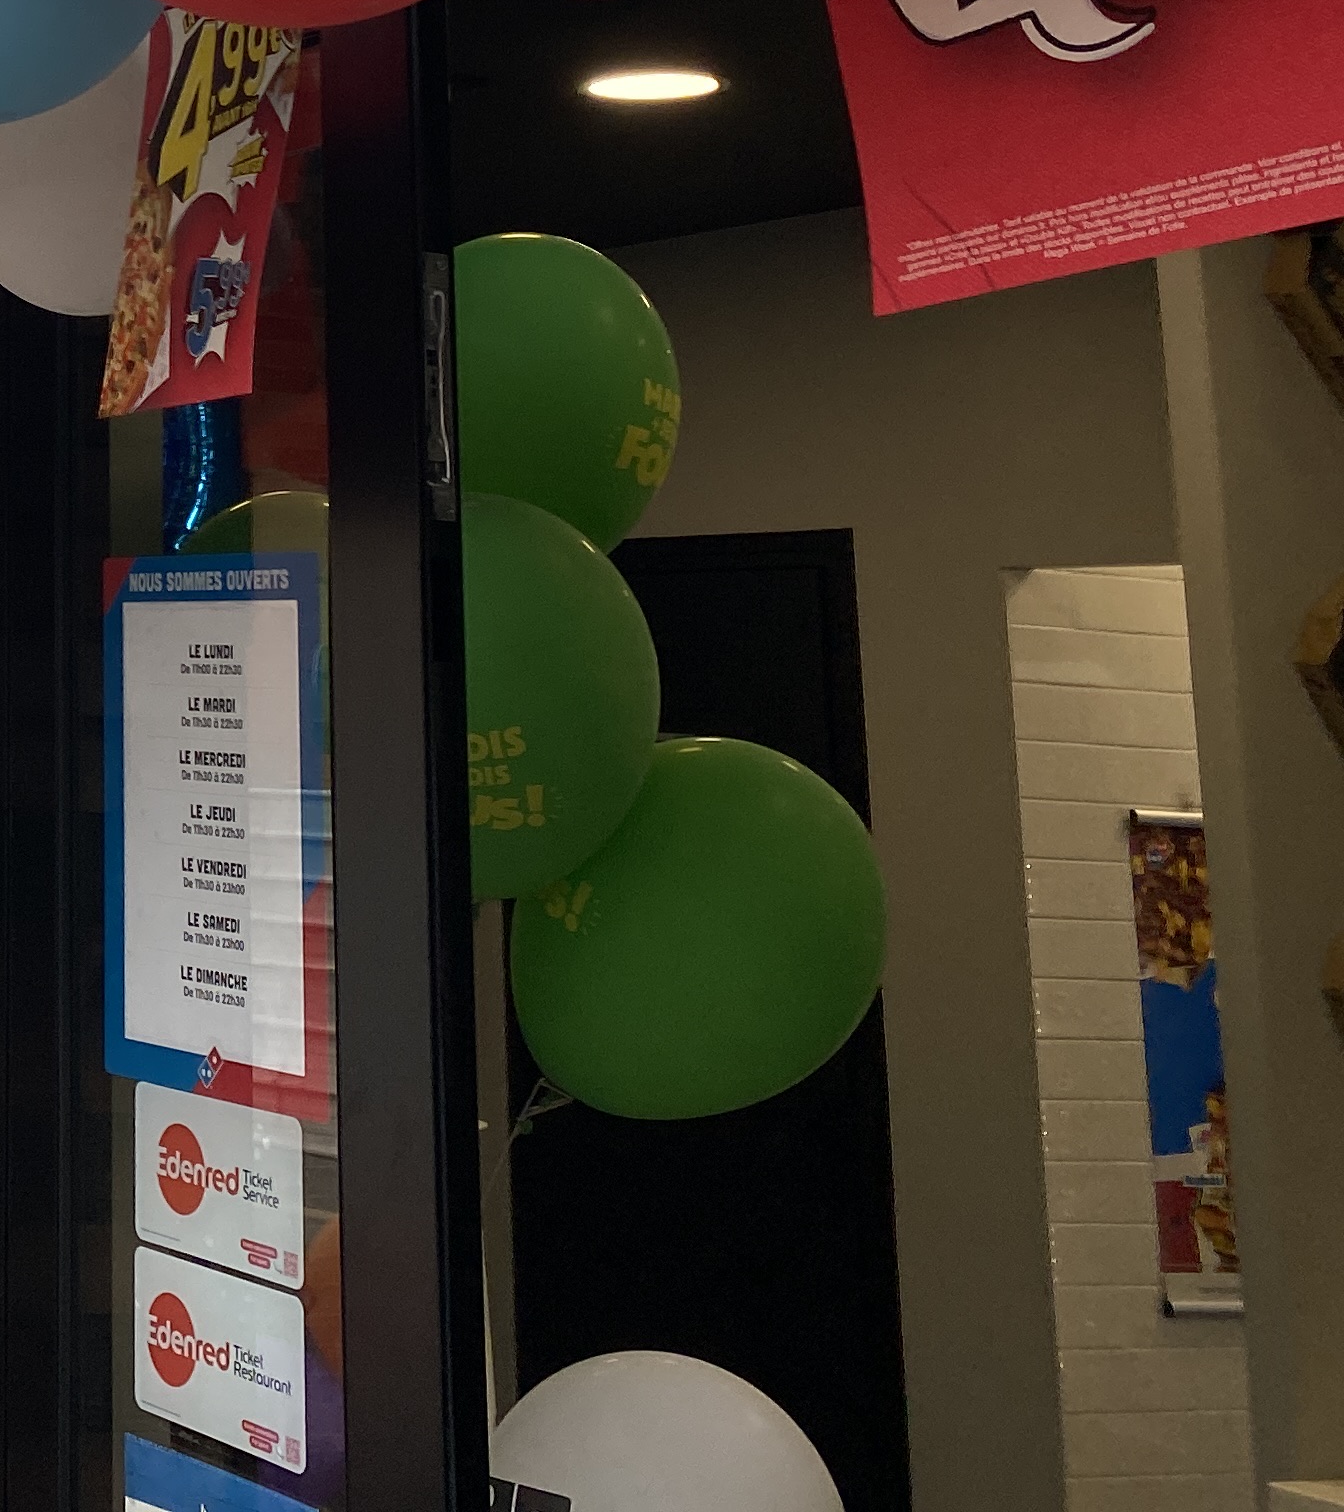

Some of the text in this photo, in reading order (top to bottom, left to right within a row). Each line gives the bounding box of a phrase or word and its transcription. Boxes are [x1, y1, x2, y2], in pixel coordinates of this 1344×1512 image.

[129, 568, 289, 592] NOUS SOMMES OUVERTS
[188, 644, 234, 659] LE LUNDI
[180, 664, 190, 674] De
[188, 696, 236, 713] LE MARDI
[181, 716, 190, 727] De
[179, 750, 245, 768] LE MERCREDI
[181, 770, 191, 780] De
[190, 804, 236, 822] LE JEUDI
[182, 823, 192, 834] De
[181, 857, 247, 879] LE VENDREDI
[183, 877, 193, 888] De
[187, 911, 240, 934] LE SAMEDI
[183, 931, 193, 942] De
[180, 965, 248, 991] LE DIMANCHE
[183, 986, 194, 997] De
[157, 1145, 239, 1196] Edenred
[242, 1168, 273, 1191] Ticket
[242, 1185, 279, 1209] Service
[147, 1314, 230, 1371] Edenred
[233, 1344, 264, 1369] Ticket
[233, 1360, 292, 1396] Restaurant
